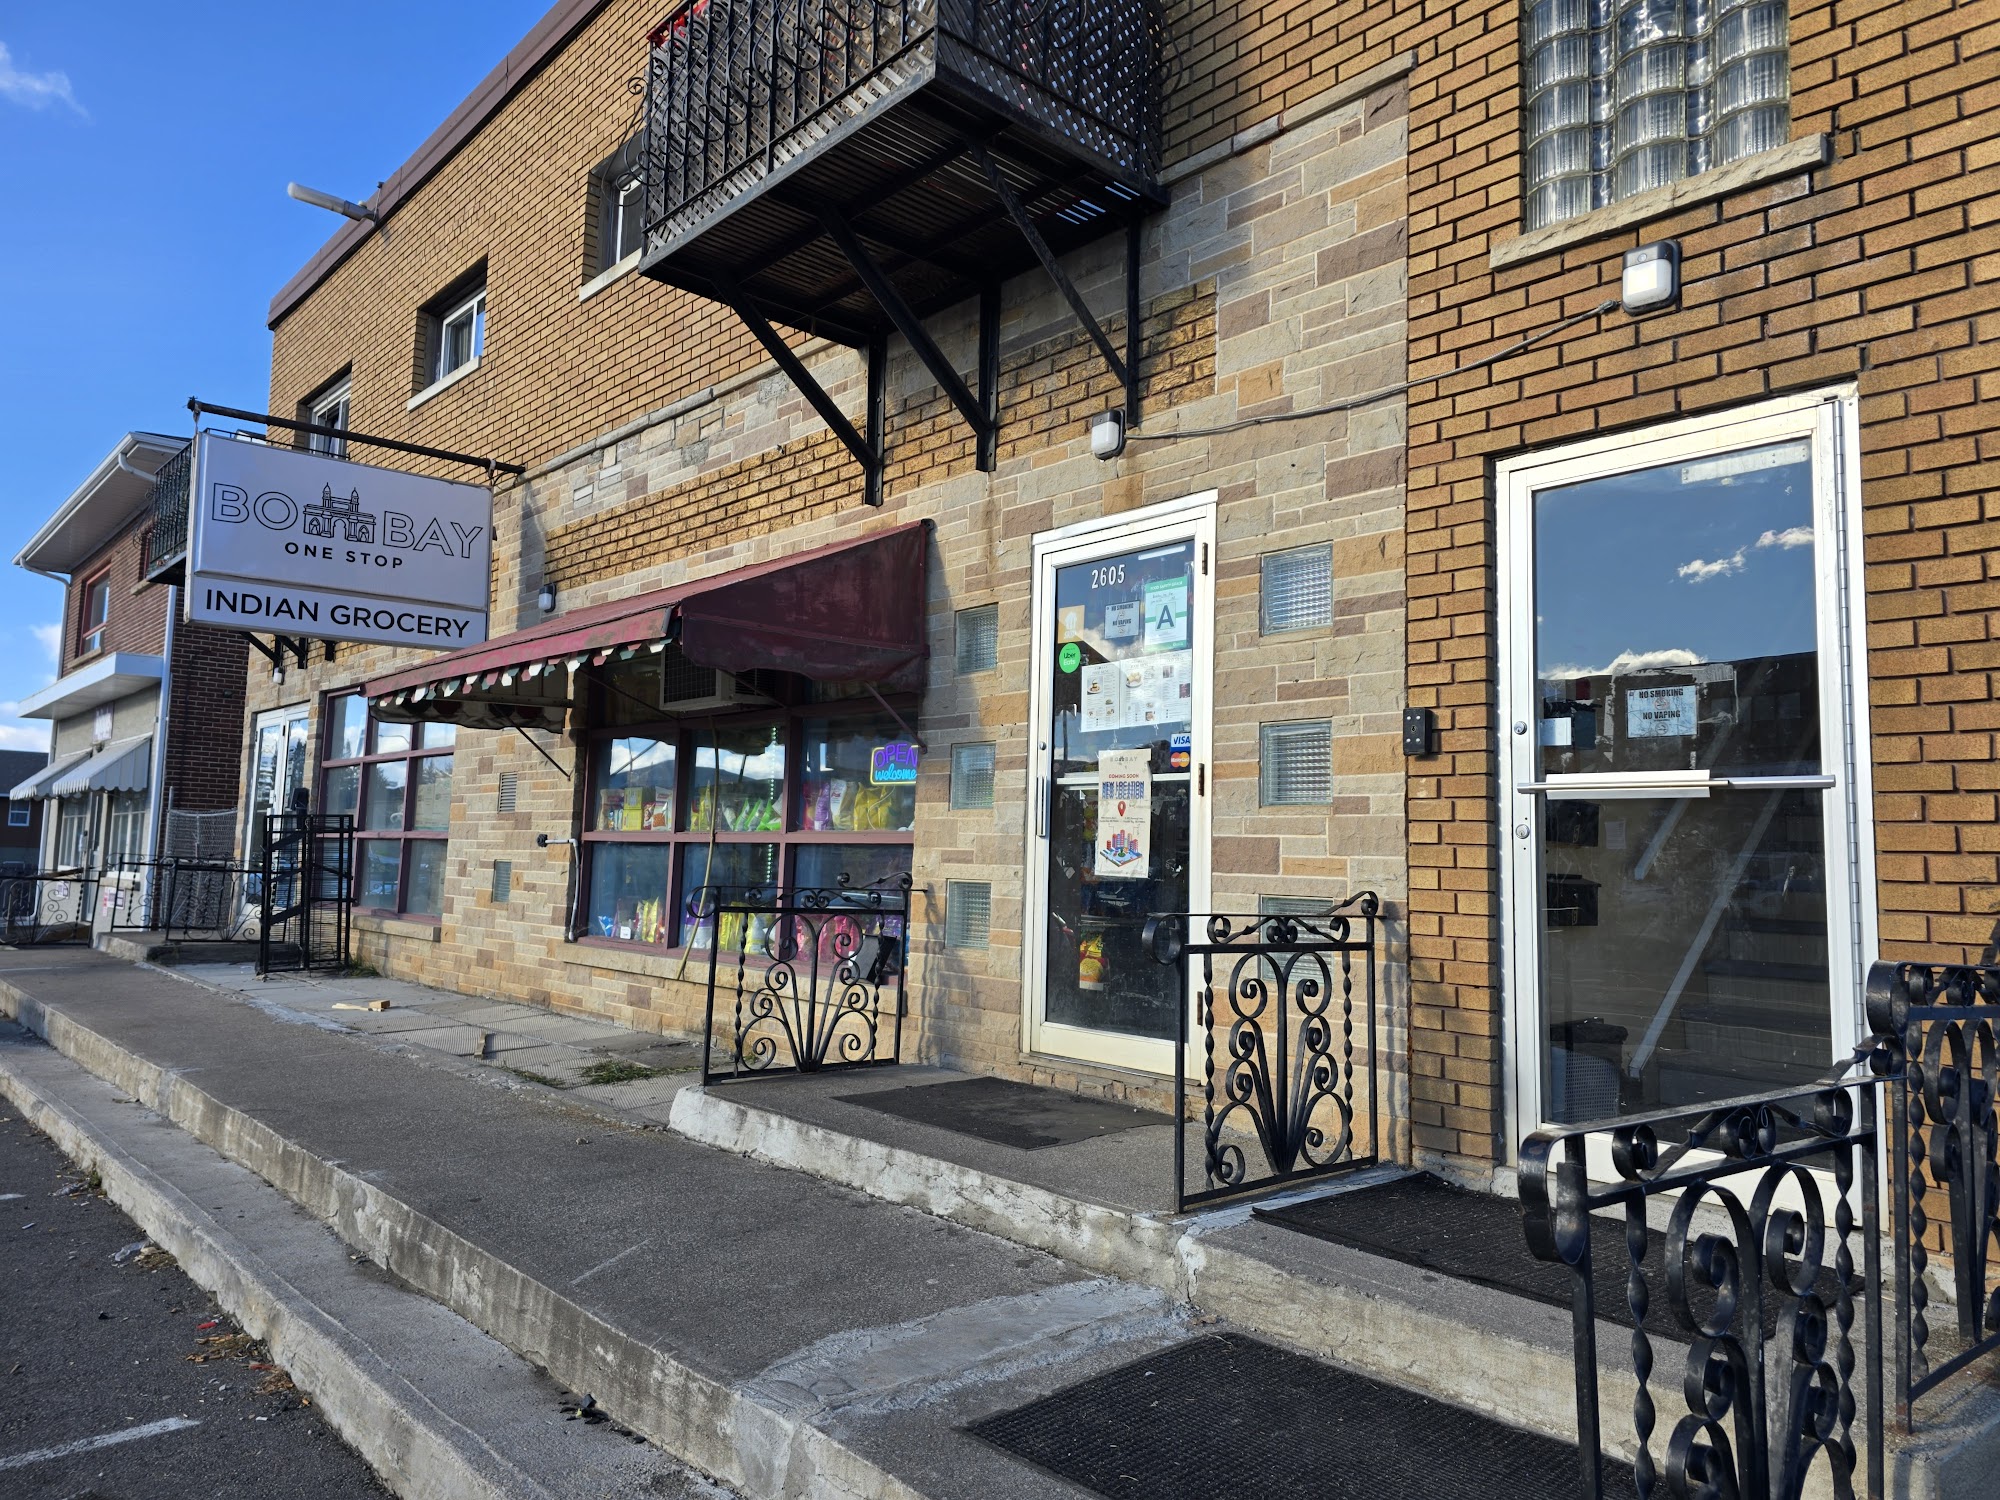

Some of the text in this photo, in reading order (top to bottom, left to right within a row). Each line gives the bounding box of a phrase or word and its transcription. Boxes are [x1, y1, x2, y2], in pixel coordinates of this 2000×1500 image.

[284, 541, 403, 569] ONE STOP
[1091, 564, 1125, 589] 2605
[206, 589, 470, 639] INDIAN GROCERY
[1156, 604, 1175, 630] A
[1639, 691, 1649, 699] NO
[1650, 689, 1683, 697] SMOKING
[1654, 710, 1680, 719] VAPING
[1174, 736, 1190, 745] VISA
[874, 743, 918, 768] OPEN
[875, 763, 918, 781] welcome
